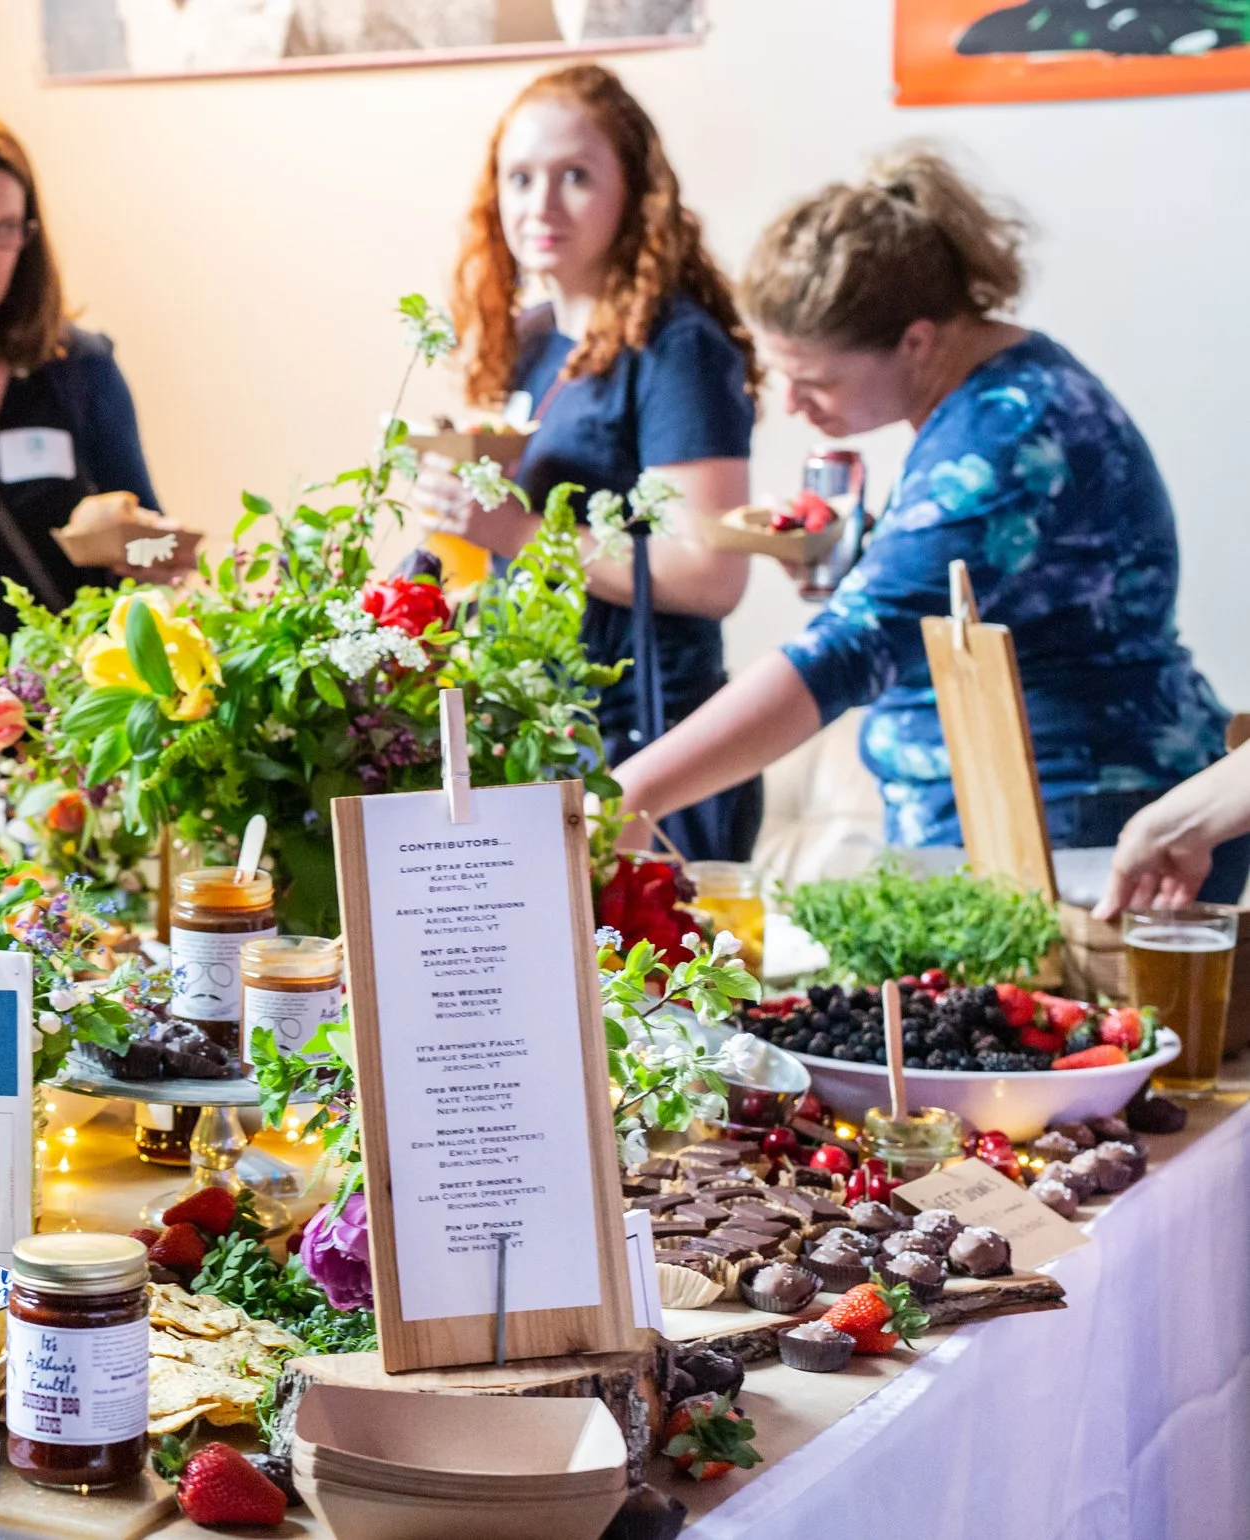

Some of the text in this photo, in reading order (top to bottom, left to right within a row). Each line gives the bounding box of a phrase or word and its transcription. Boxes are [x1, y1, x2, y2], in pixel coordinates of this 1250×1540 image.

[465, 860, 514, 869] CATERING
[396, 901, 525, 916] ARIEL'S HONEY INFUSIONS
[446, 947, 468, 955] GRL
[471, 945, 507, 953] STUDIO
[448, 1084, 490, 1093] WEAVER
[493, 1082, 520, 1090] FARM
[438, 1096, 460, 1104] KATE
[500, 1102, 513, 1110] VT
[477, 1124, 517, 1133] MARKET
[438, 1138, 476, 1147] MALONE
[449, 1149, 478, 1157] EMILY
[506, 1155, 519, 1163] VT
[439, 1181, 473, 1189] SWEET
[442, 1191, 477, 1200] CURTIS
[504, 1198, 517, 1206] VT
[482, 1220, 523, 1229] PICKLES
[450, 1234, 487, 1242] RACHEL
[511, 1240, 525, 1248] VT
[42, 1333, 58, 1352] It's
[25, 1350, 76, 1373] Arthur's
